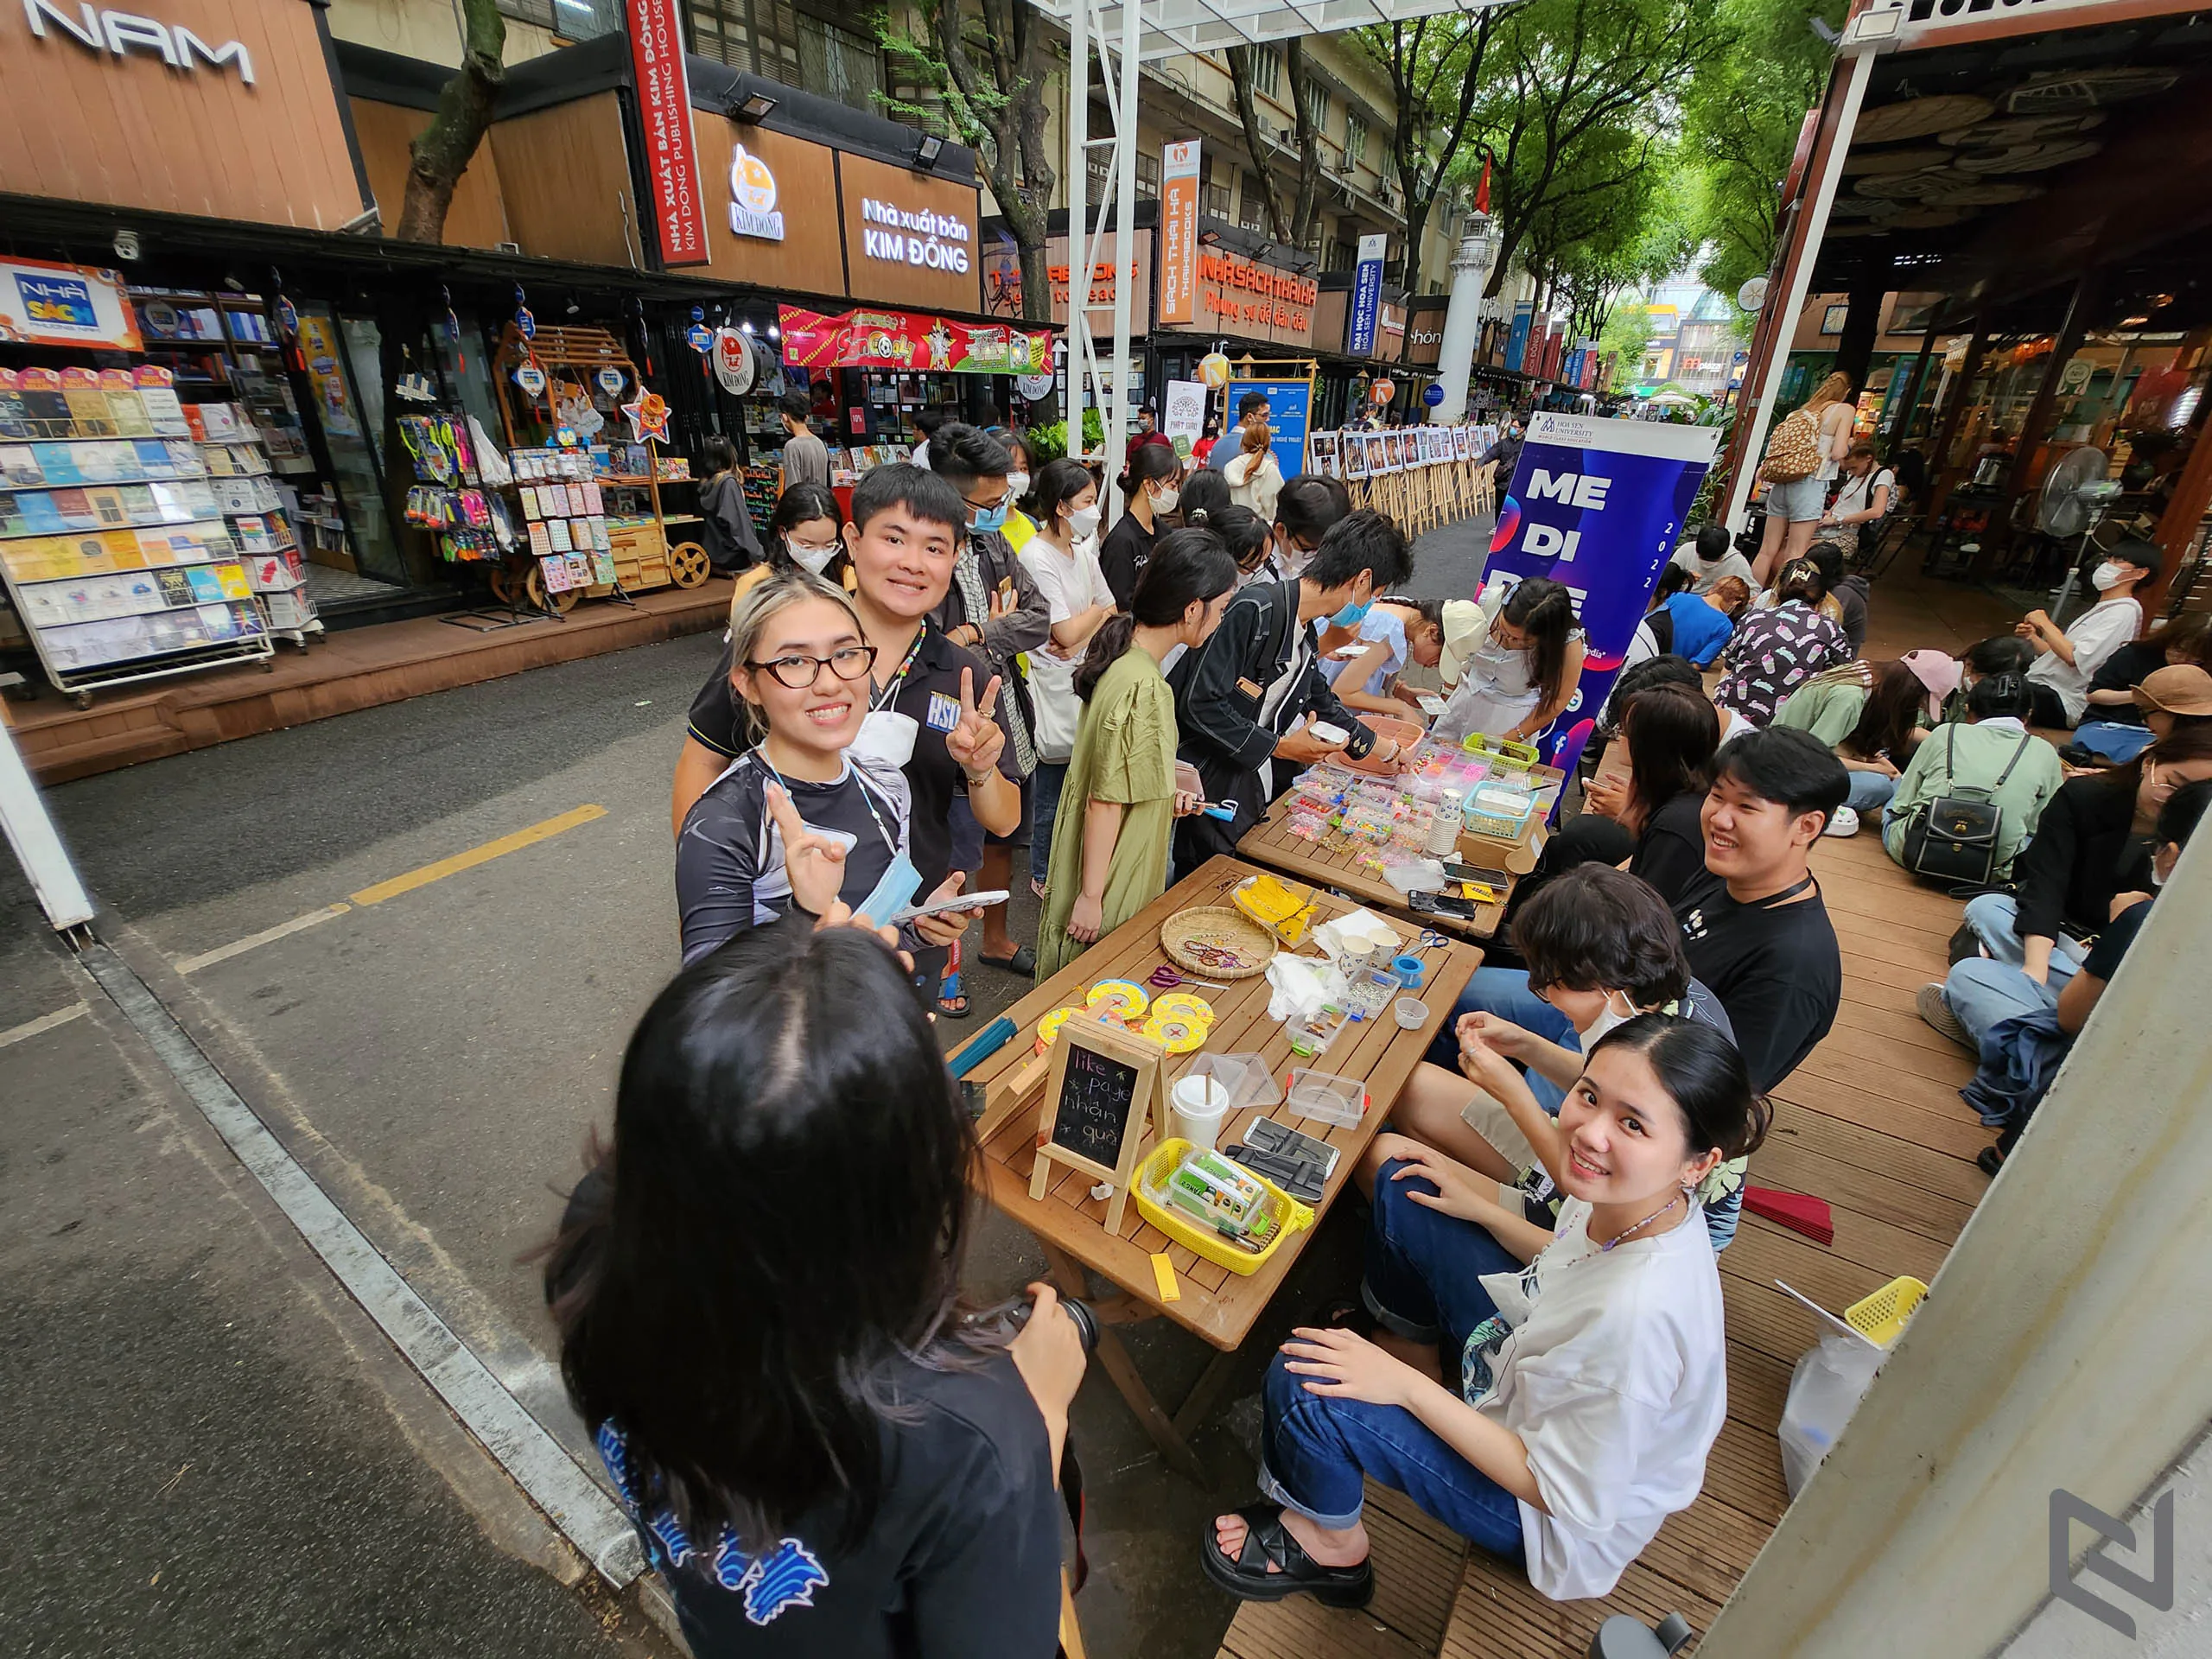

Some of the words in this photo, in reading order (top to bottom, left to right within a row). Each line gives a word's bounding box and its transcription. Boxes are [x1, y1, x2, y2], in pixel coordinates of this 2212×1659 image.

[22, 0, 256, 84] NAM
[648, 67, 662, 106] KIM
[653, 111, 669, 150] BẢN
[661, 62, 684, 160] PUBLISHING
[658, 156, 677, 207] XUẤT
[675, 163, 691, 217] DONG
[734, 207, 754, 232] KIM
[862, 197, 899, 226] Nhà
[899, 208, 937, 234] xuất
[938, 215, 969, 242] bản
[1168, 188, 1179, 216] HÀ
[666, 211, 682, 252] NHÀ
[683, 221, 696, 251] KIM
[864, 228, 904, 262] KIM
[907, 235, 969, 274] ĐỒNG
[20, 281, 88, 301] NHÀ
[1165, 265, 1178, 315] SÁCH
[1200, 254, 1234, 285] NHÀ
[1233, 261, 1273, 296] SÁCH
[1273, 275, 1302, 304] THÁI
[1301, 280, 1317, 308] HÀ
[1360, 264, 1370, 283] SEN
[1366, 264, 1376, 314] UNIVERSITY
[1358, 285, 1367, 310] HOA
[1356, 310, 1365, 331] HỌC
[1556, 428, 1593, 437] UNIVERSITY
[1526, 468, 1612, 511] ME
[1521, 523, 1582, 563] DI
[927, 696, 962, 731] HSU
[1074, 1049, 1107, 1077] like
[1064, 1094, 1117, 1124] nhận
[1083, 1123, 1117, 1147] quà
